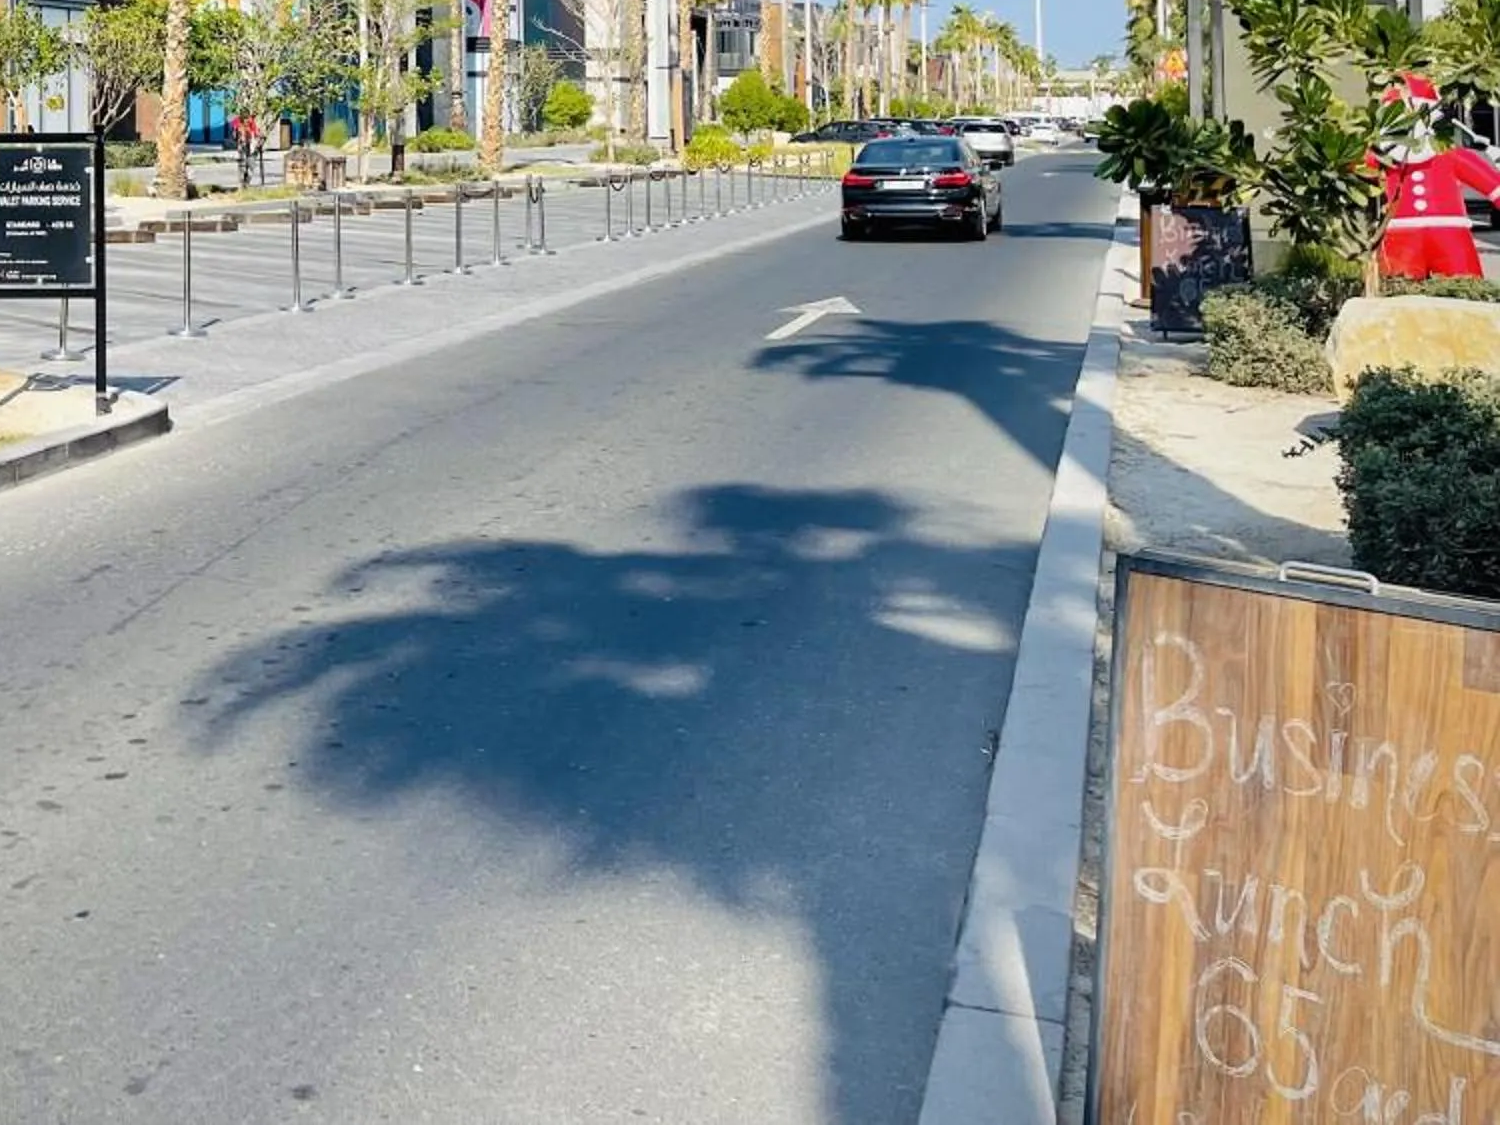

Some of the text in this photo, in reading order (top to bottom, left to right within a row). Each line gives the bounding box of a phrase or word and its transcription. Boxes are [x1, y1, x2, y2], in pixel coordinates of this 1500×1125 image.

[21, 195, 51, 206] PARKING
[51, 195, 81, 206] SERVICE
[1130, 631, 1500, 847] Busines
[1196, 956, 1321, 1101] 65
